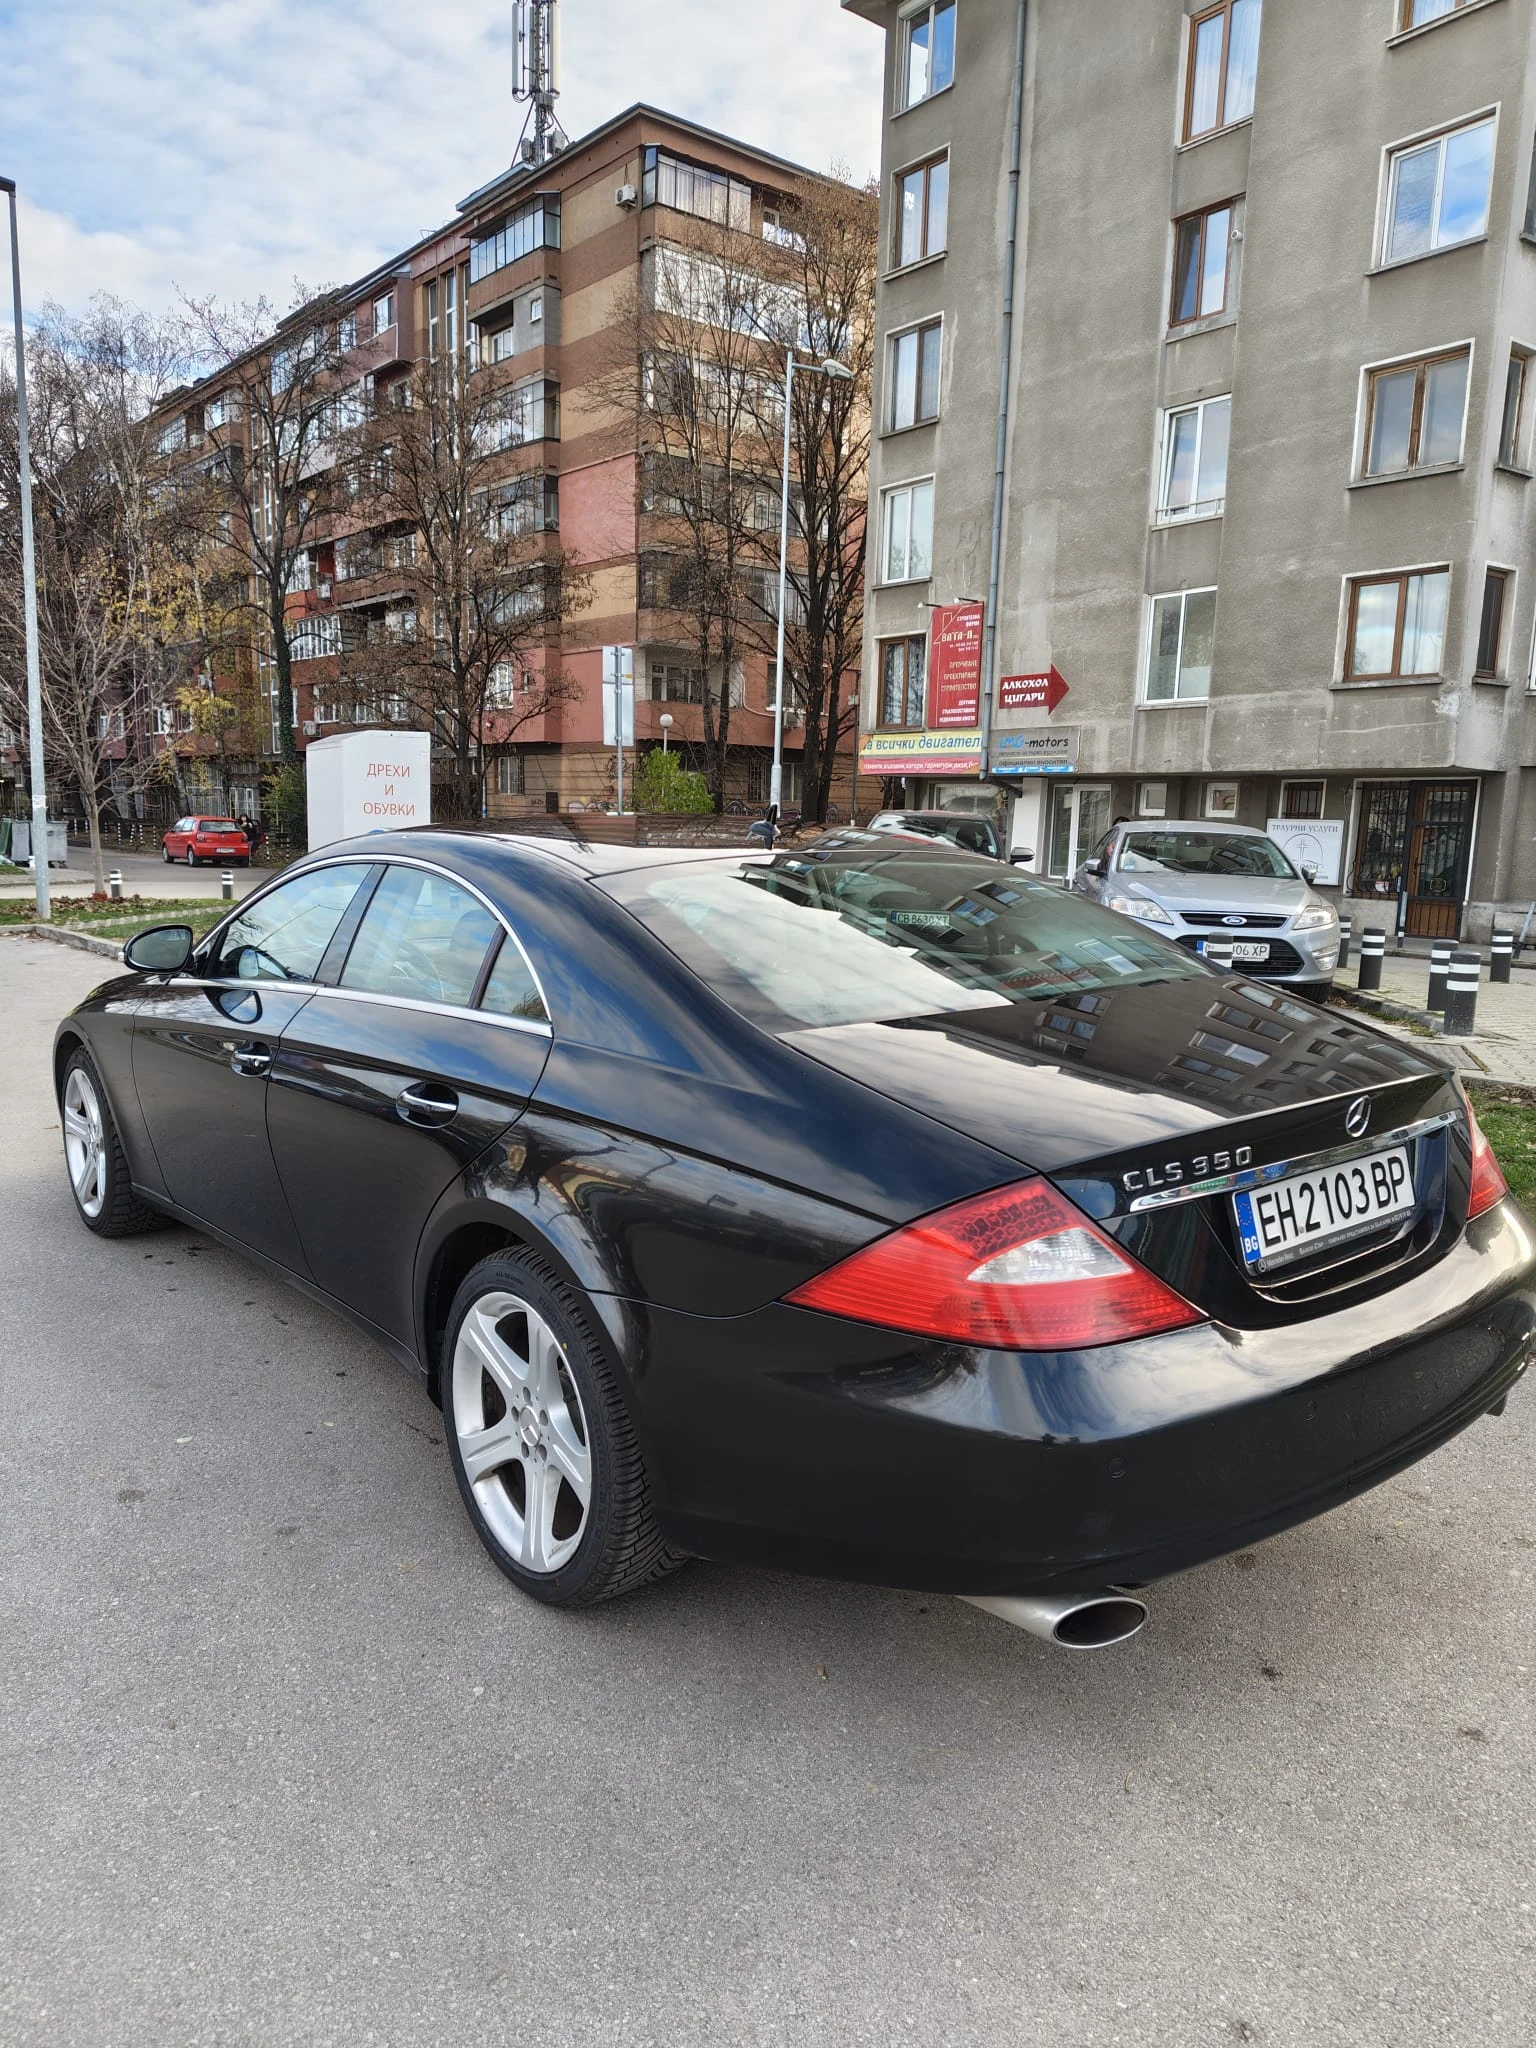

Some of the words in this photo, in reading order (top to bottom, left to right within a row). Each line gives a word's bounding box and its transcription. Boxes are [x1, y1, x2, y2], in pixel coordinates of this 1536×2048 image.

[1002, 678, 1049, 690] АЛКОХОЛ
[1004, 692, 1045, 704] ЦИГАРИ
[876, 739, 915, 750] всички
[367, 763, 410, 778] ДРЕХИ
[384, 783, 394, 796] И
[363, 802, 415, 816] ОБУВКИ
[1272, 824, 1306, 832] ТРАУРНИ
[1122, 1162, 1184, 1192] CLS
[1192, 1145, 1252, 1176] 350
[1244, 1237, 1259, 1253] BG
